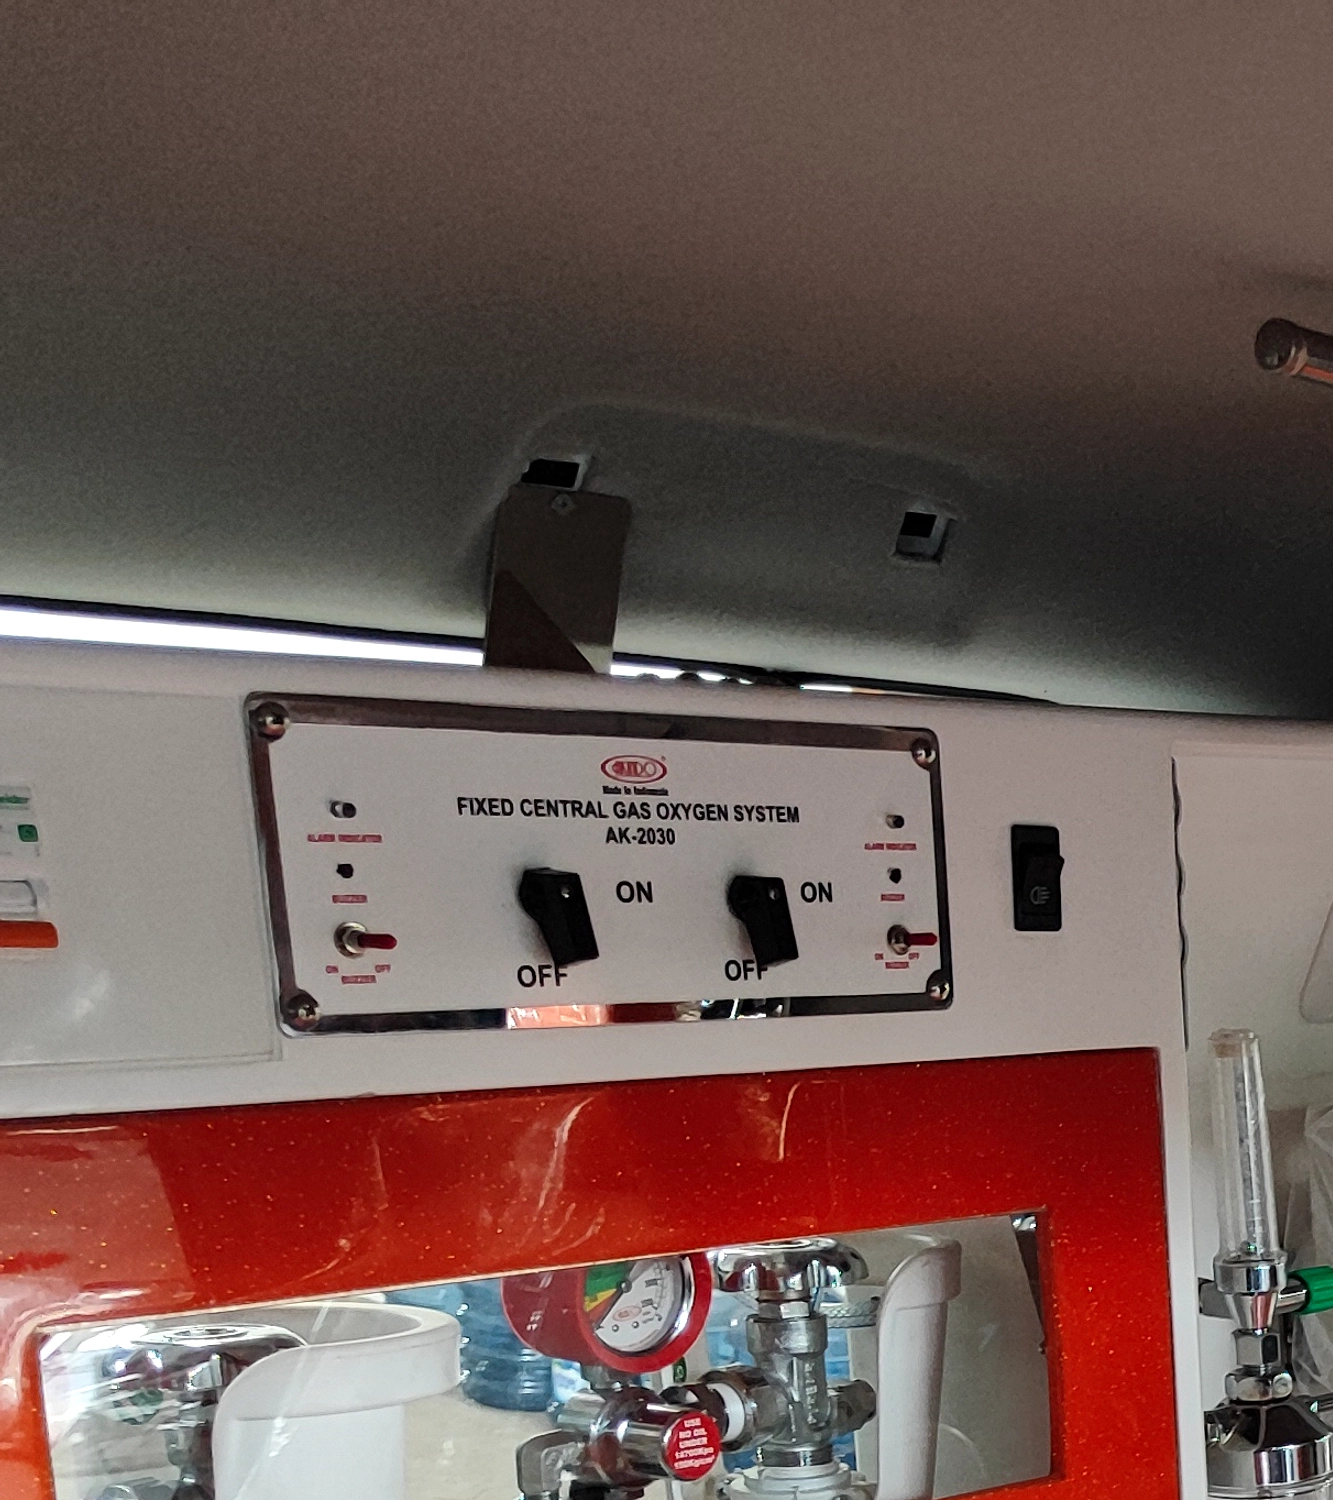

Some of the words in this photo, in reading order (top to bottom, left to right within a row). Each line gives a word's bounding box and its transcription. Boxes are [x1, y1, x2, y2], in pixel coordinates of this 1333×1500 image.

[457, 796, 514, 817] FIXED
[519, 798, 609, 820] CENTRAL
[613, 801, 651, 820] GAS
[656, 802, 729, 823] OXYGEN
[733, 804, 800, 824] SYSTEM
[605, 826, 676, 845] AK-2030
[615, 881, 653, 904] ON
[800, 881, 833, 904] ON
[517, 964, 568, 988] OFF
[724, 959, 768, 982] OFF
